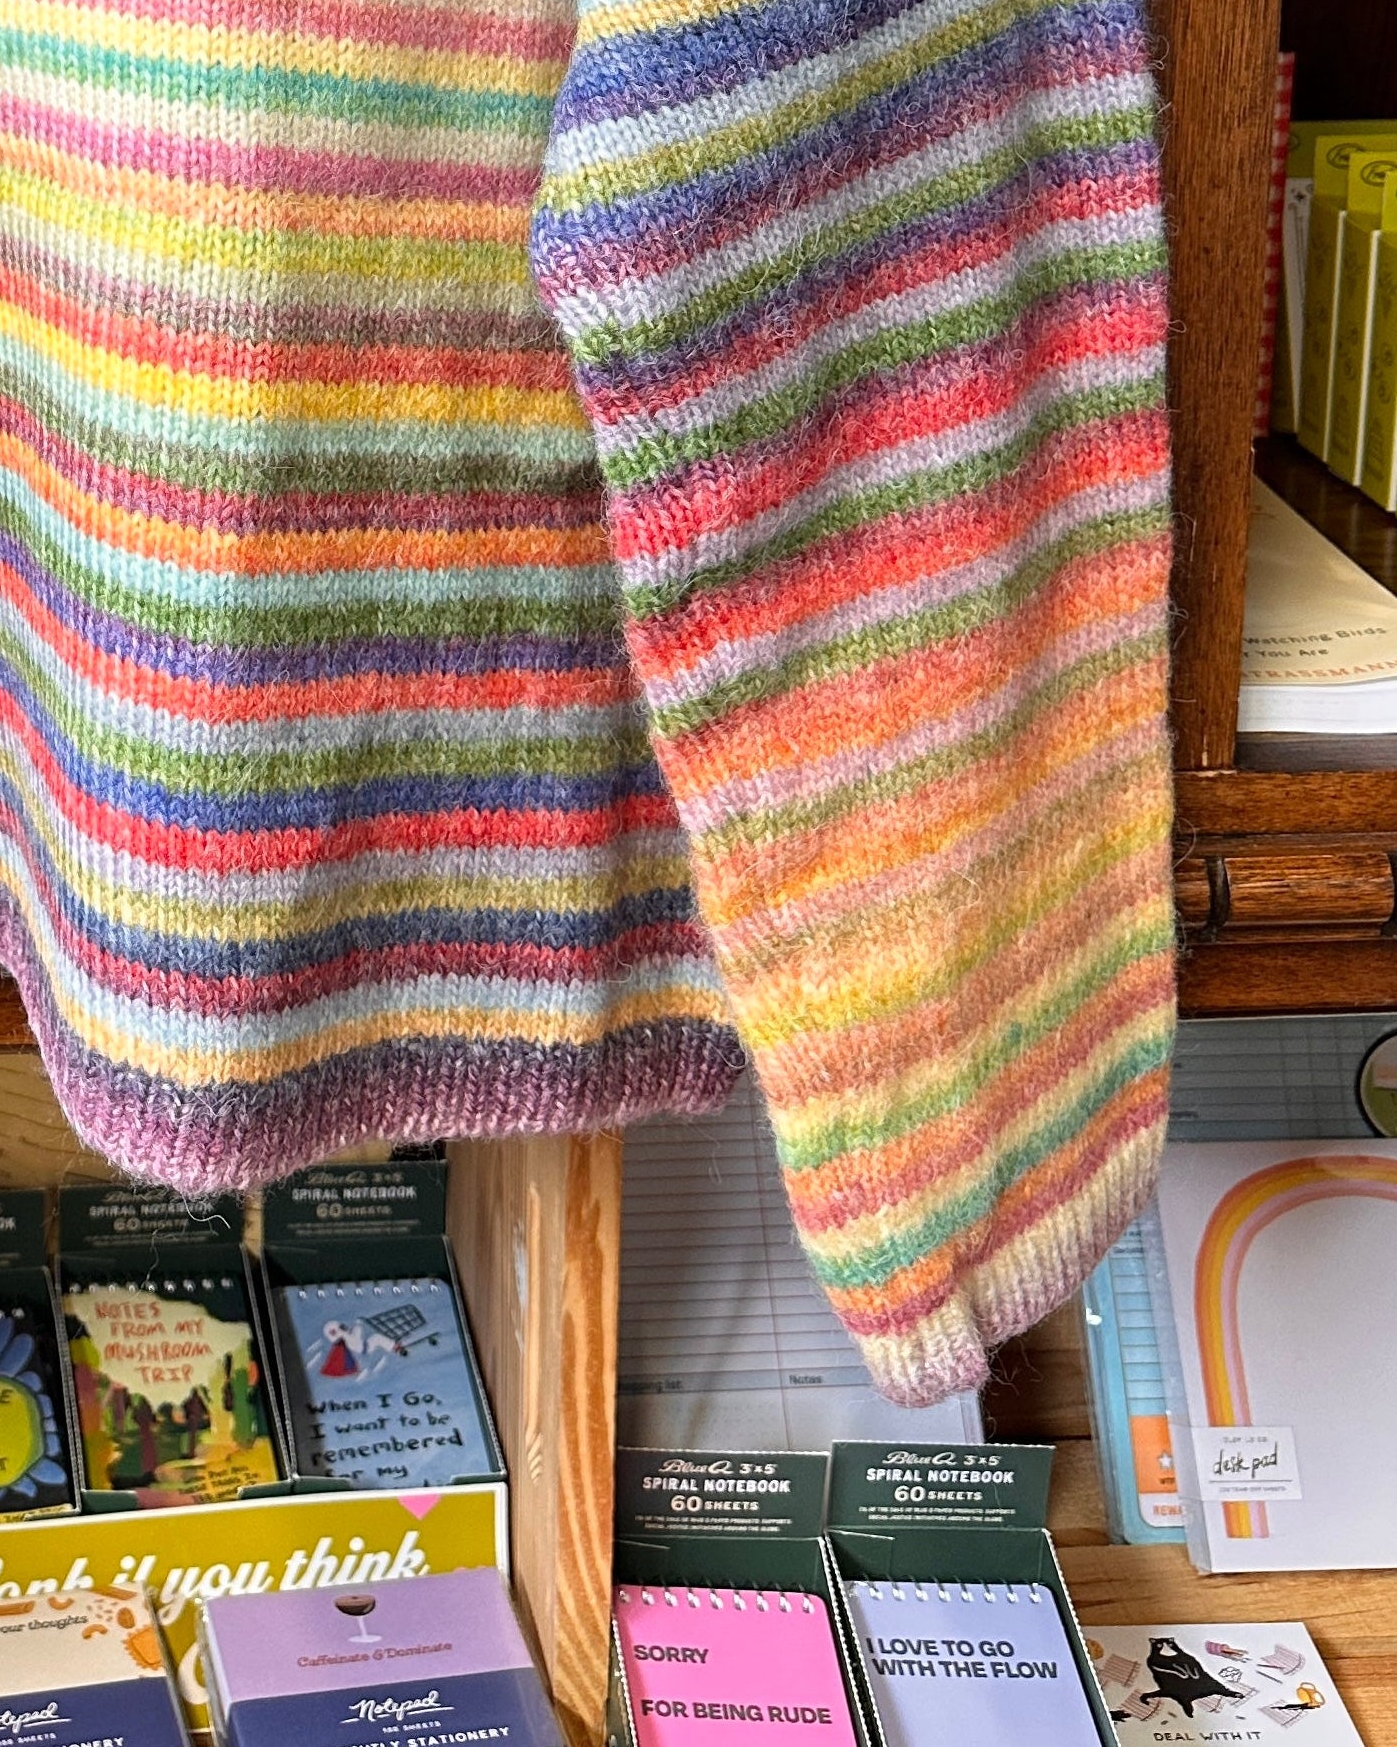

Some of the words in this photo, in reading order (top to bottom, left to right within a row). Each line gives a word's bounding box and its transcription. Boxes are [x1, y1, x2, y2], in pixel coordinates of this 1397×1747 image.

[1243, 632, 1333, 646] Watching
[1335, 626, 1387, 639] Birds
[1255, 649, 1291, 658] You
[1298, 648, 1330, 657] Are
[343, 1184, 417, 1201] NOTEBOOK
[94, 1301, 162, 1321] NOTES
[110, 1321, 166, 1338] FROM
[175, 1318, 205, 1336] MY
[105, 1341, 214, 1363] MUSHROOM
[135, 1364, 195, 1384] TRIP
[789, 1373, 823, 1385] Notes
[306, 1397, 368, 1415] When
[377, 1392, 393, 1408] I
[309, 1422, 326, 1440] I
[335, 1417, 391, 1434] want
[400, 1413, 421, 1428] to
[427, 1410, 452, 1426] be
[310, 1427, 465, 1467] remembered
[1213, 1449, 1250, 1475] desk
[1251, 1441, 1278, 1480] pad
[377, 1464, 409, 1479] my
[865, 1468, 923, 1483] SPIRAL
[927, 1469, 1015, 1484] NOTEBOOK
[643, 1476, 699, 1492] SPIRAL
[703, 1479, 792, 1493] NOTEBOOK
[893, 1485, 926, 1503] 60
[927, 1491, 984, 1501] SHEETS
[671, 1494, 703, 1512] 60
[704, 1500, 760, 1511] SHEETS
[158, 1560, 275, 1624] you
[276, 1530, 431, 1589] think
[27, 1613, 89, 1632] thoughts
[297, 1650, 370, 1669] Caffeinate
[384, 1640, 452, 1660] Dominate
[633, 1644, 710, 1664] SORRY
[865, 1636, 875, 1654] I
[877, 1638, 940, 1656] LOVE
[941, 1639, 975, 1657] TO
[978, 1640, 1015, 1658] GO
[871, 1657, 937, 1677] WITH
[938, 1659, 988, 1678] THE
[991, 1661, 1058, 1679] FLOW
[348, 1690, 444, 1722] Notepad
[640, 1699, 688, 1718] FOR
[693, 1702, 765, 1722] BEING
[767, 1705, 834, 1725] RUDE
[406, 1726, 510, 1747] STATIONERY
[1153, 1731, 1195, 1742] DEAL
[1201, 1731, 1241, 1741] WITH
[1247, 1730, 1263, 1741] IT
